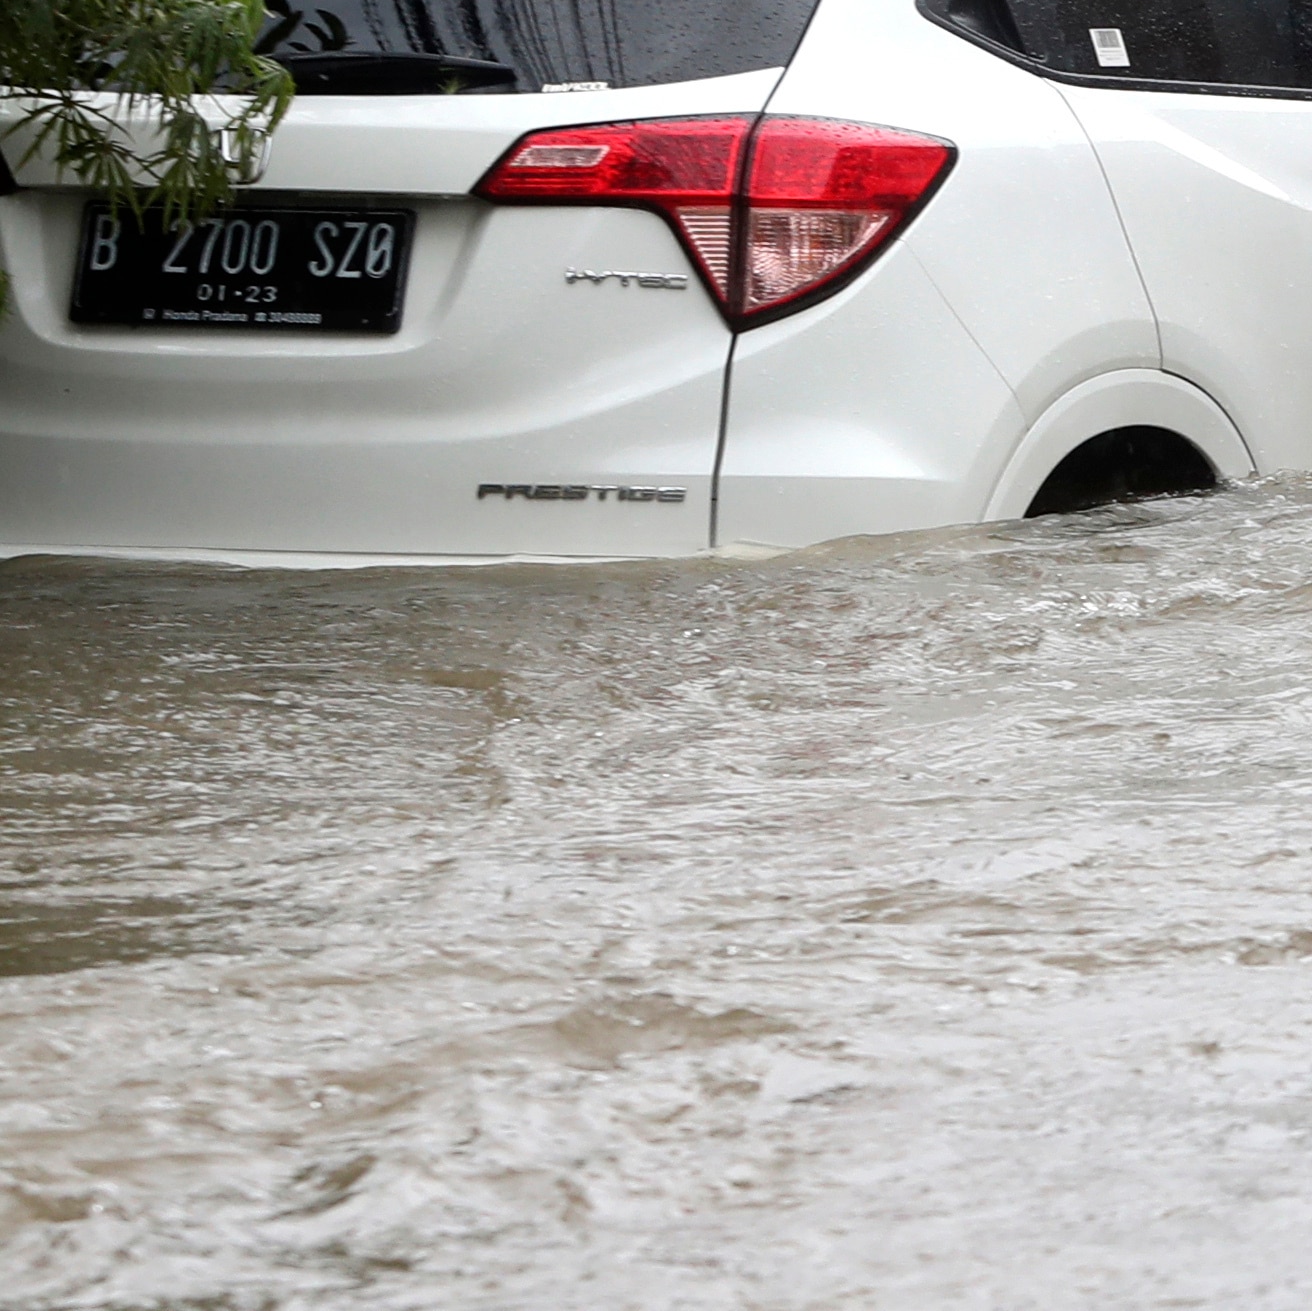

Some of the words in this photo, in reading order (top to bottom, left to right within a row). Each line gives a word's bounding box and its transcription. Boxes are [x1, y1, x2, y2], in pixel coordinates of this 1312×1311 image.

[90, 214, 121, 271] B
[162, 218, 279, 275] 2700
[477, 483, 688, 503] PRESTIGE
